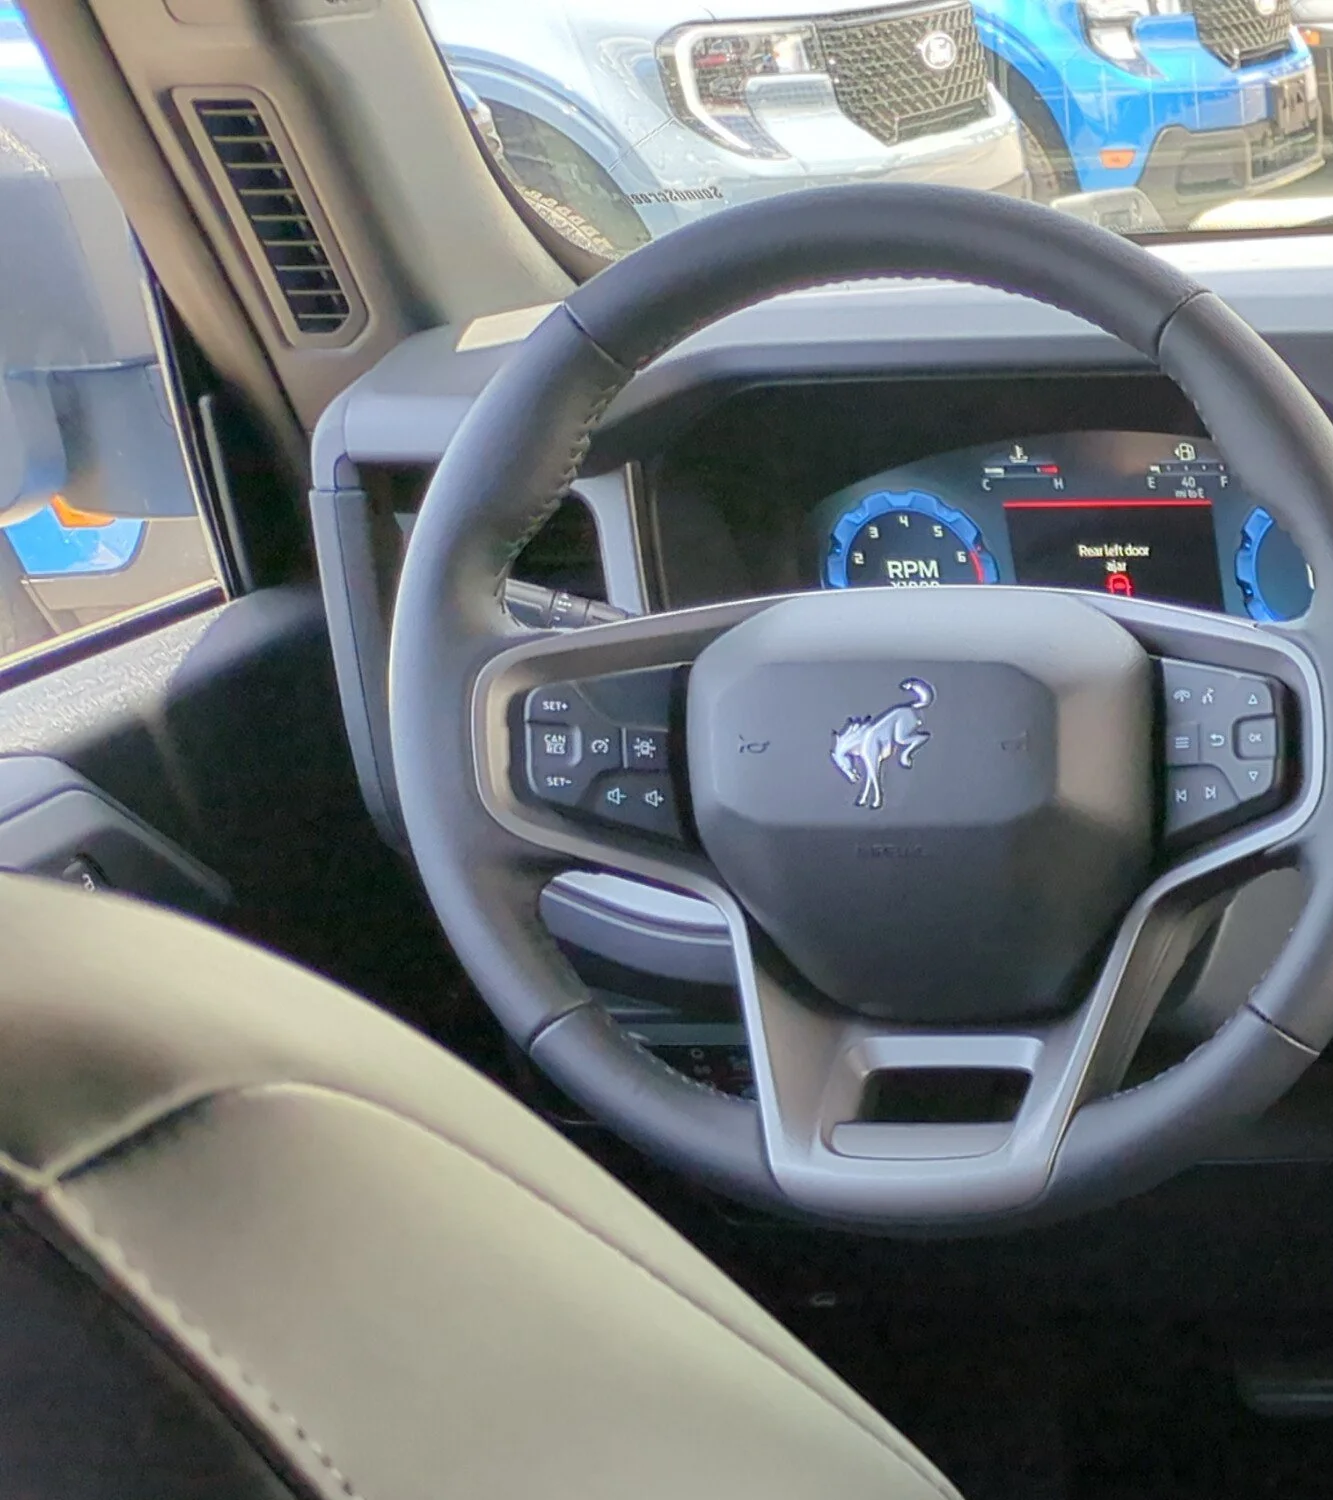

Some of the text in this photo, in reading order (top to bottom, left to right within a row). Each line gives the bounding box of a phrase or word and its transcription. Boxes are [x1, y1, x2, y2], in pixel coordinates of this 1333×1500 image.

[982, 478, 991, 491] C
[1053, 478, 1064, 490] H
[1147, 477, 1156, 489] E
[1181, 477, 1196, 489] 40
[1220, 476, 1228, 488] F
[899, 516, 909, 527] 4
[869, 526, 880, 539] 3
[933, 525, 944, 537] 5
[1078, 543, 1149, 557] Rear left door
[853, 552, 864, 565] 2
[956, 551, 967, 563] 6
[887, 560, 940, 579] RPM
[1106, 559, 1126, 574] ajar
[542, 701, 568, 711] SET+
[544, 734, 566, 743] CAN
[1248, 733, 1262, 743] OK
[546, 777, 572, 787] SET-
